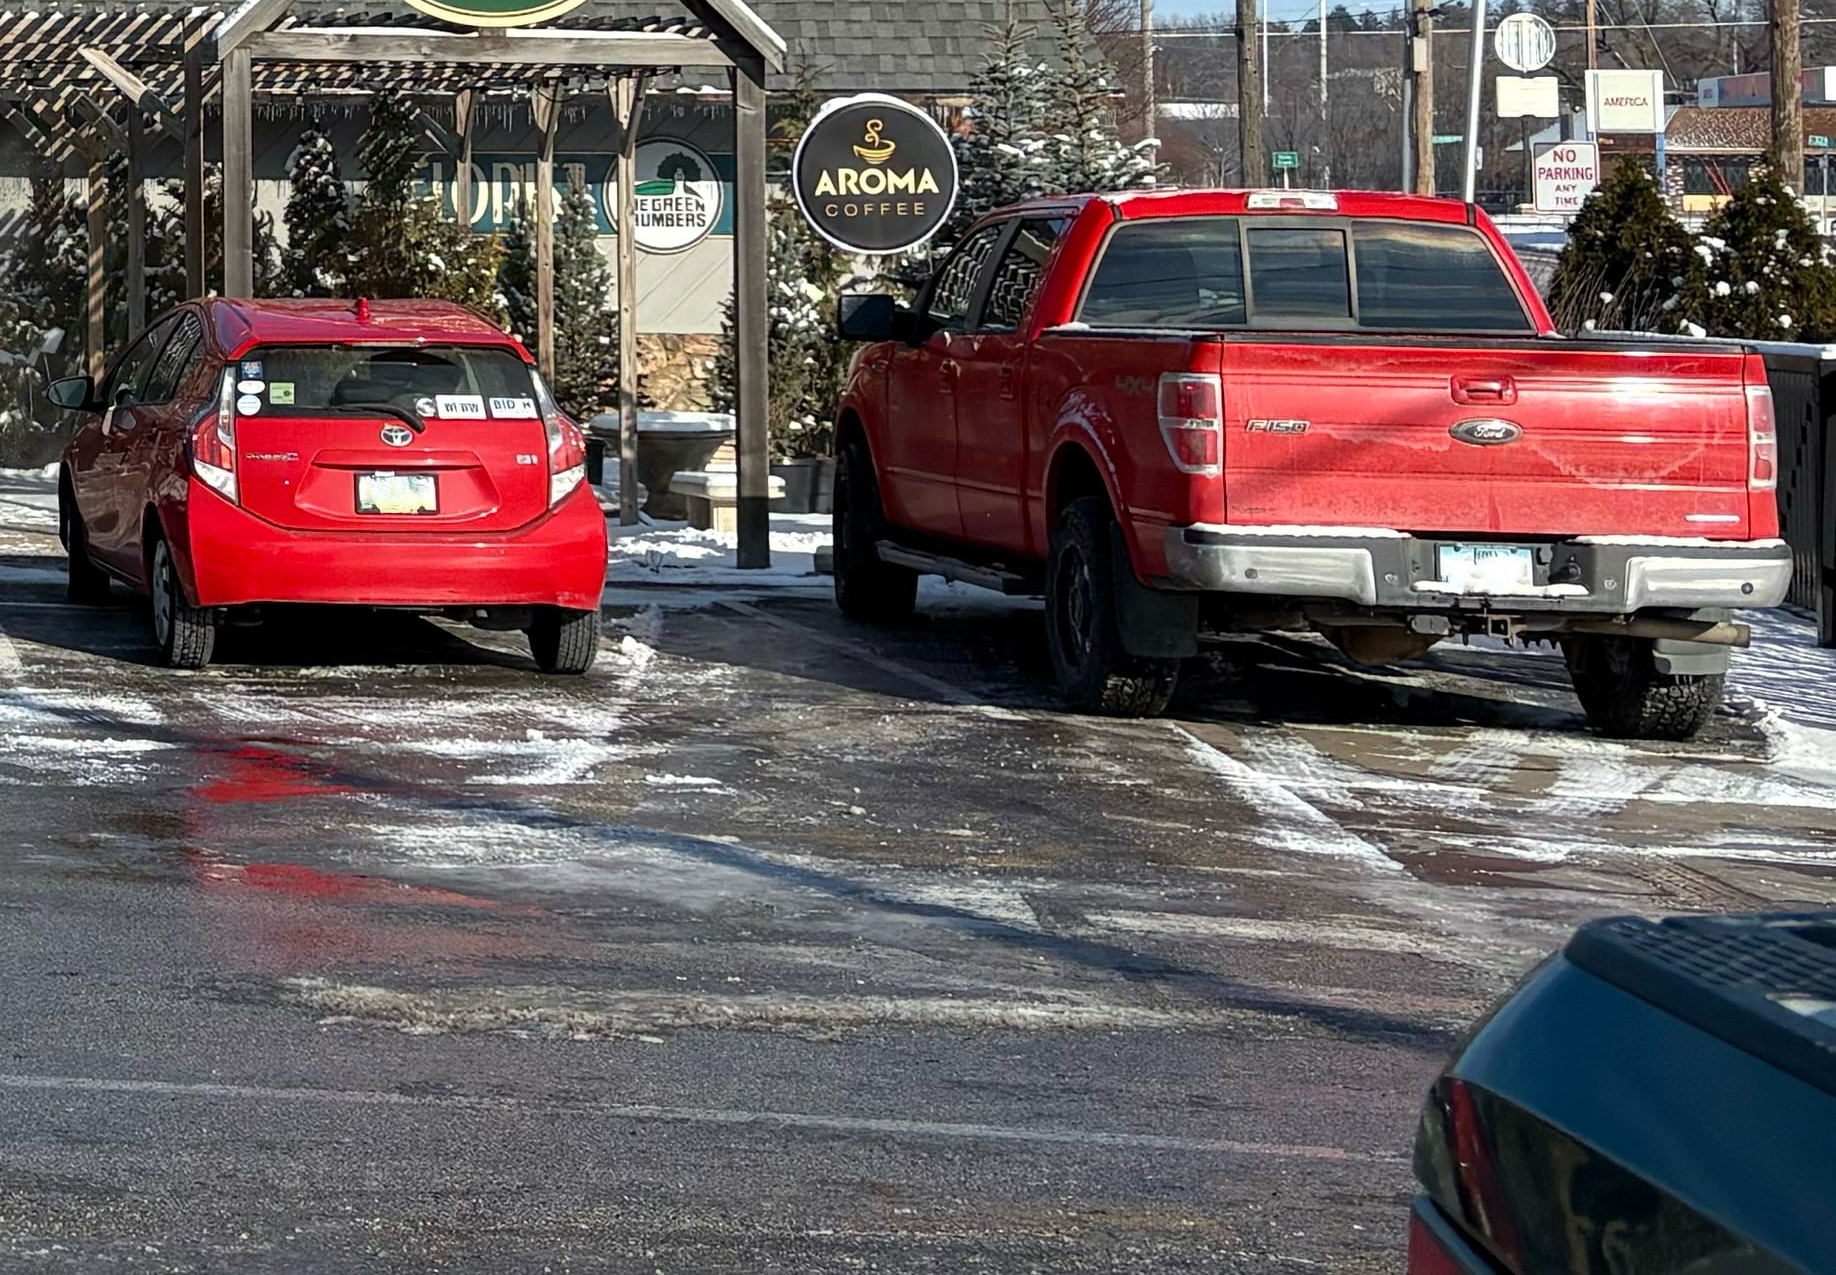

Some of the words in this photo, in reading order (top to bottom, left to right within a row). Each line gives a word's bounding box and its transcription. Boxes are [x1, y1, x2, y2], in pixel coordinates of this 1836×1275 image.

[1604, 97, 1649, 107] AMERICA
[1553, 149, 1577, 163] NO
[1538, 167, 1593, 181] PARKING
[814, 167, 940, 197] AROMA
[1555, 184, 1577, 193] ANY
[651, 197, 706, 212] GREEN
[1555, 196, 1578, 206] TIME
[825, 202, 925, 217] COFFEE
[634, 213, 707, 227] UMBERS
[1473, 419, 1507, 439] Ford
